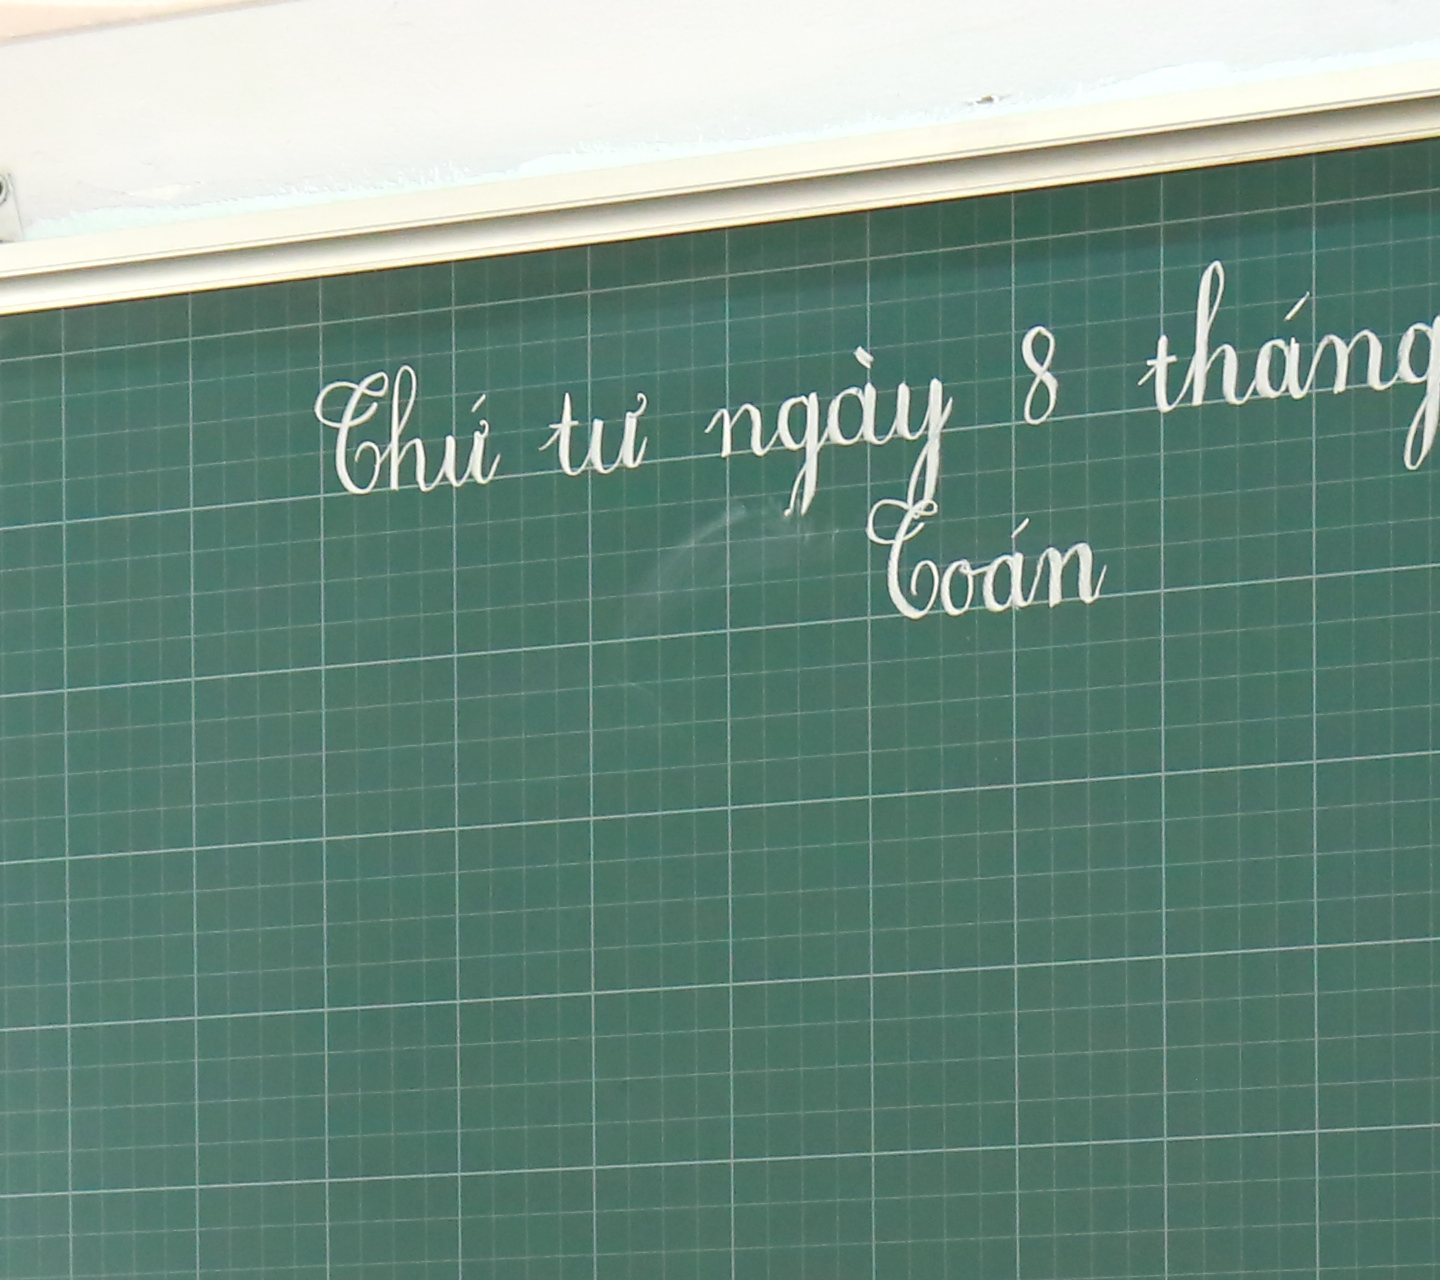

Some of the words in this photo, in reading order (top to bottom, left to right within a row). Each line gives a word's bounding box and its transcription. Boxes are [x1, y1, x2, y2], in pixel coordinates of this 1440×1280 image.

[314, 365, 501, 495] Thứ
[704, 346, 953, 517] ngày
[1020, 325, 1059, 426] 8
[866, 498, 1106, 620] Toán
